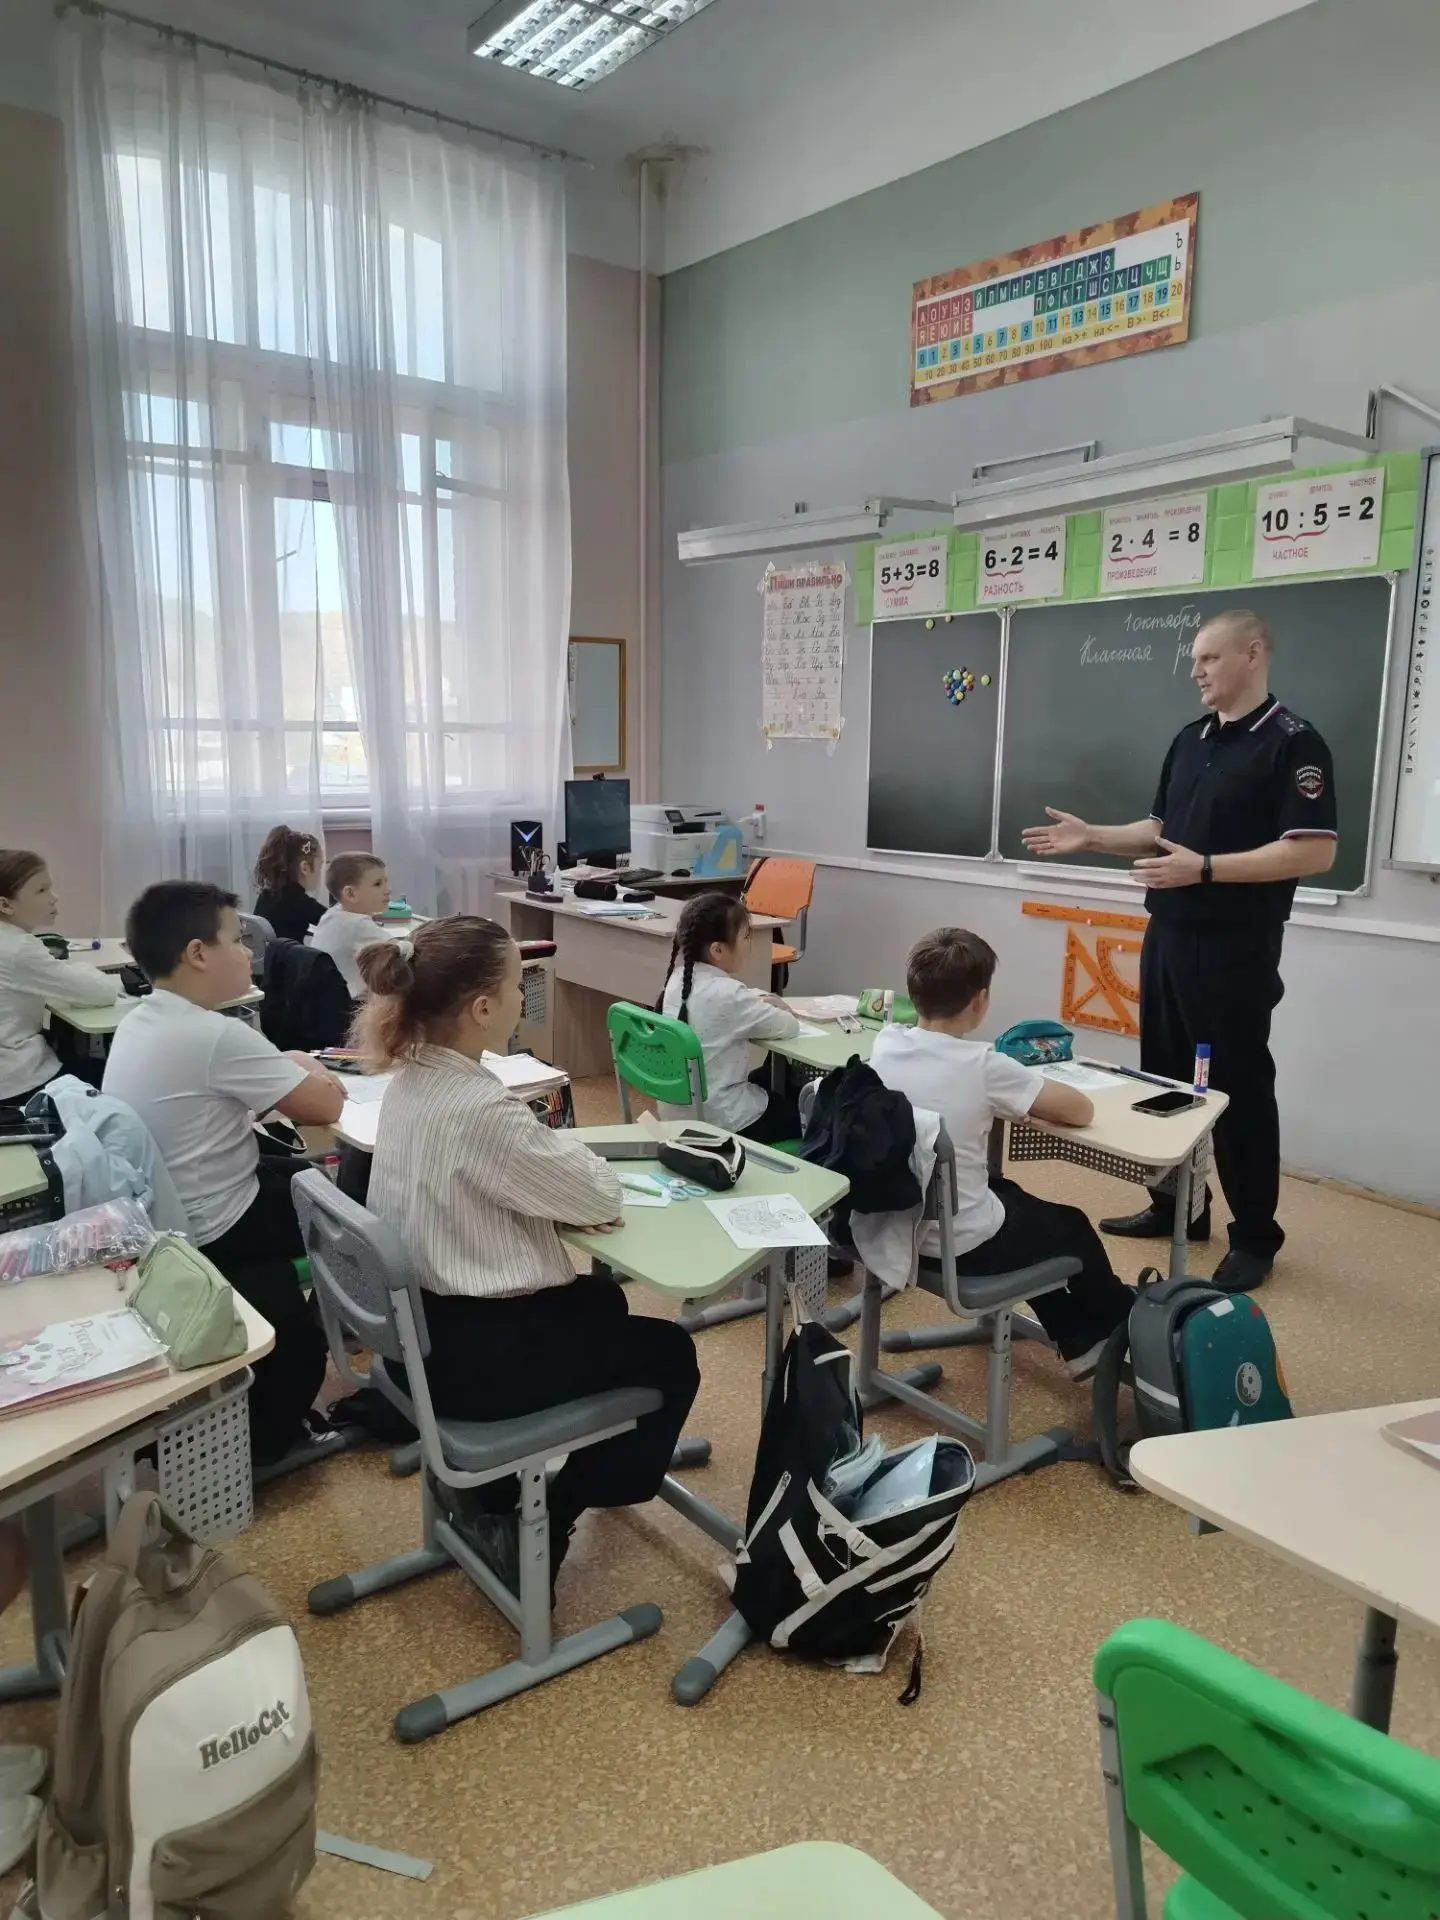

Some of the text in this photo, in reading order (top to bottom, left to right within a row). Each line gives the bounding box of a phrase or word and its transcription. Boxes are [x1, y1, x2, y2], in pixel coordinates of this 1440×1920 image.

[1262, 508, 1289, 532] 10
[1273, 547, 1308, 560] ЧАСТНОЕ
[984, 582, 1024, 597] РАЗНОСТЬ
[1080, 634, 1154, 667] Классная
[199, 1700, 290, 1770] HelloCat
